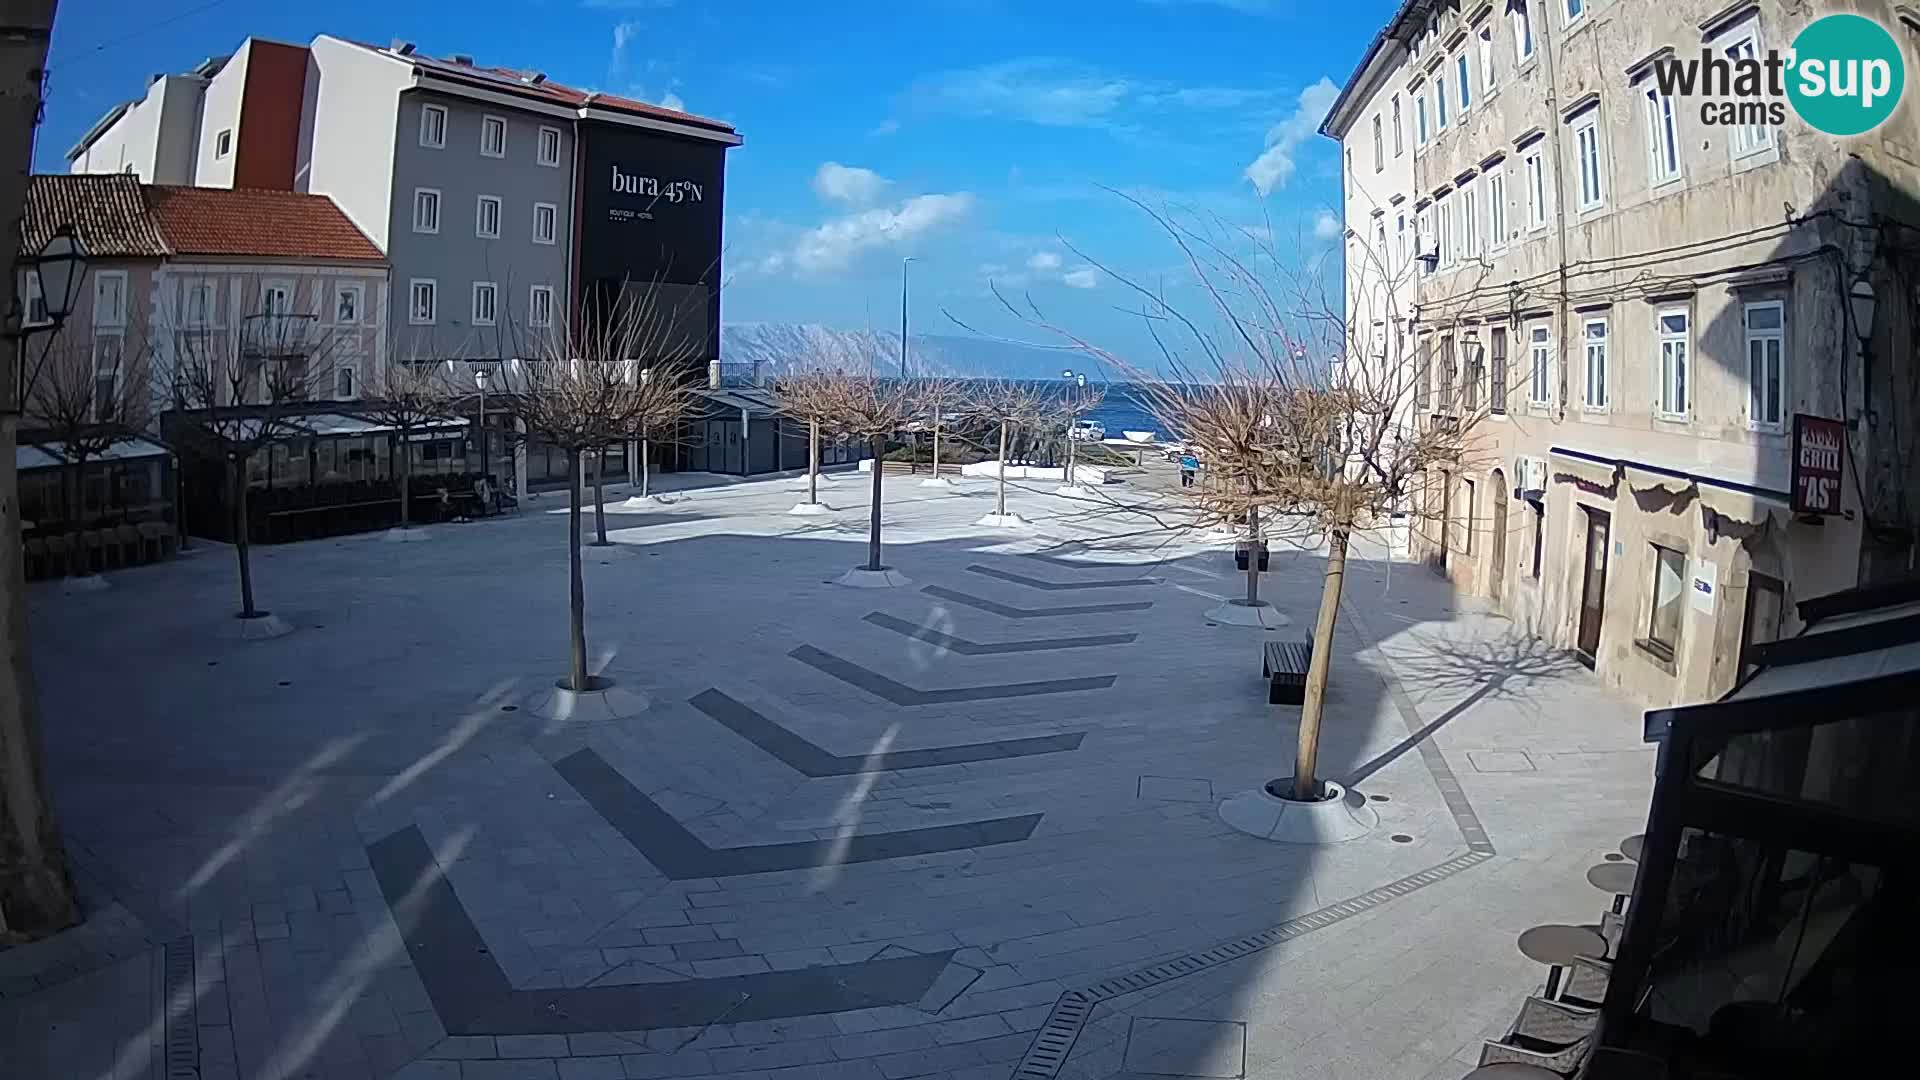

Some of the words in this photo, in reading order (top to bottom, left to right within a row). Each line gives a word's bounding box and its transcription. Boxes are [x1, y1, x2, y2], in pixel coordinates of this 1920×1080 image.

[612, 165, 658, 196] bura
[609, 209, 635, 217] BOUTIQUE
[637, 212, 654, 220] HOTEL
[1800, 447, 1840, 472] GRILL
